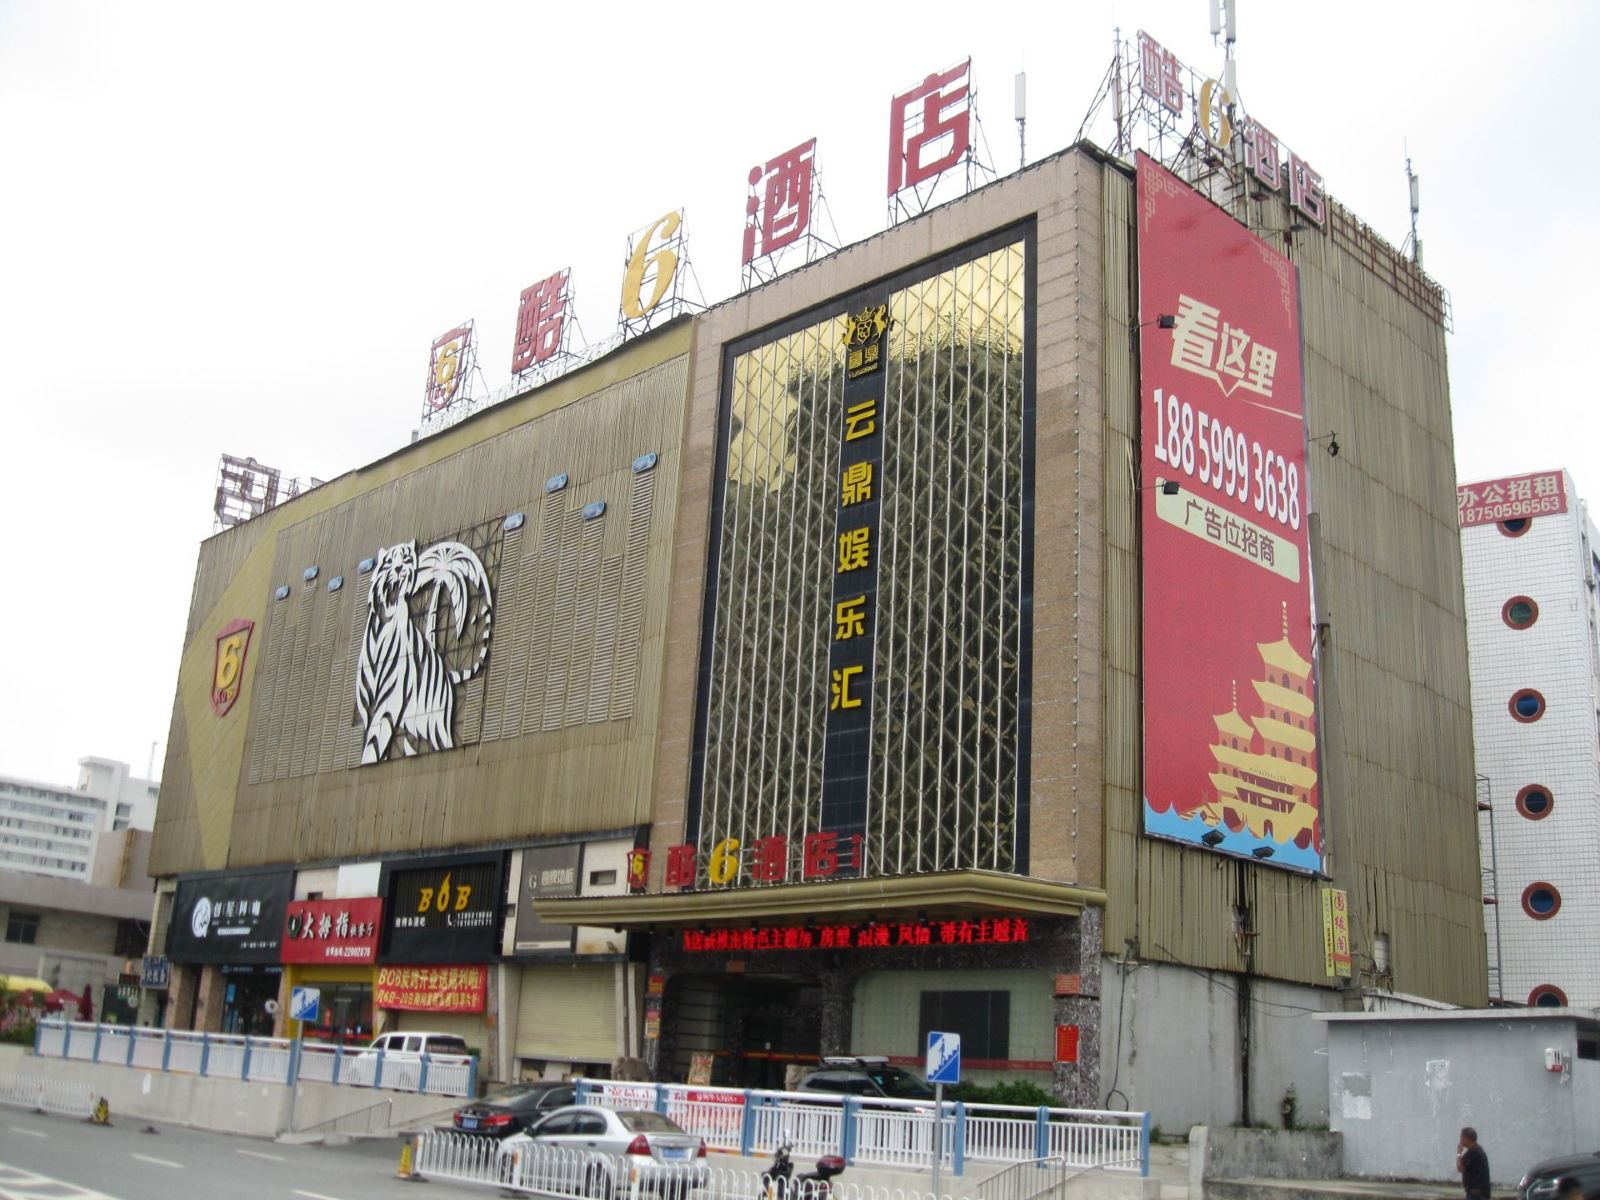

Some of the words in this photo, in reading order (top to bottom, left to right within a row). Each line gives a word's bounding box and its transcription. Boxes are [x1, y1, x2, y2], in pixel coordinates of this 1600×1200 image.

[512, 61, 970, 372] 酷6酒店
[1168, 293, 1278, 397] 看这里
[1458, 475, 1560, 509] 办公招租
[1459, 496, 1560, 523] 18750596563
[831, 399, 876, 712] 云鼎娱乐汇
[1184, 499, 1275, 568] 广告位招商
[665, 831, 840, 887] 酷6酒店
[417, 871, 472, 913] BOB
